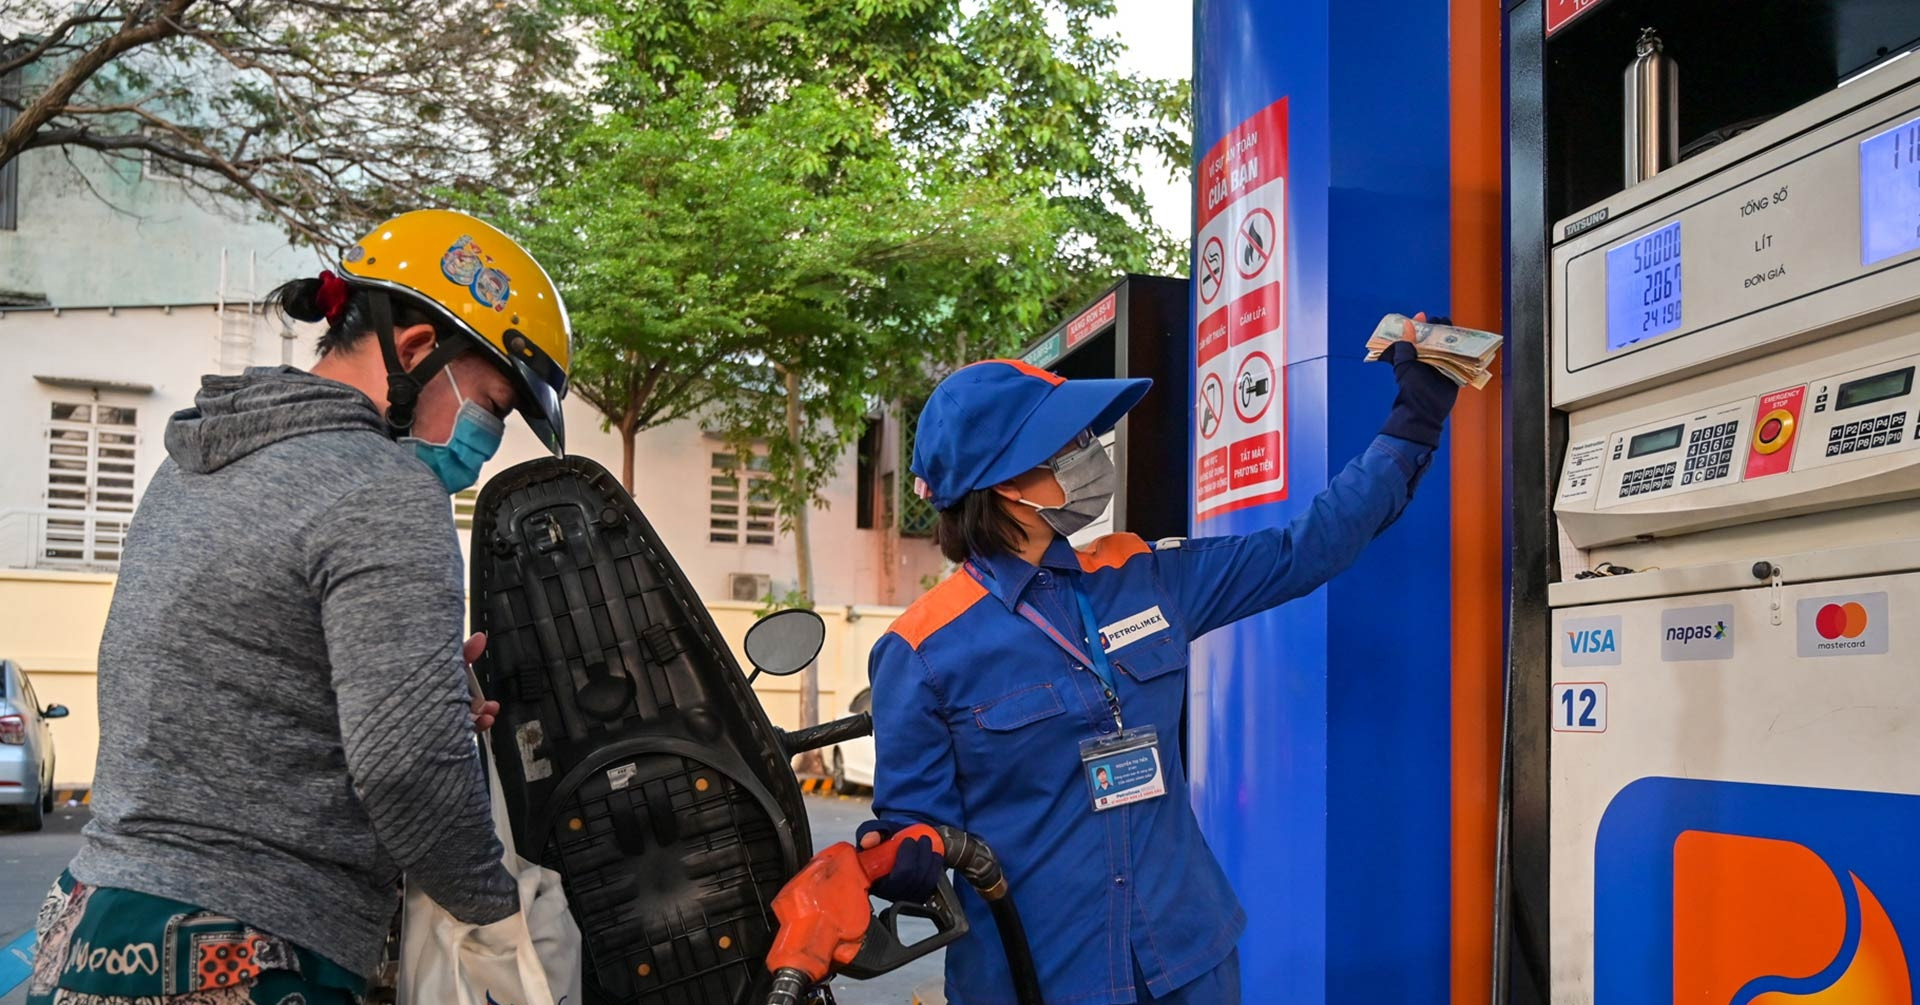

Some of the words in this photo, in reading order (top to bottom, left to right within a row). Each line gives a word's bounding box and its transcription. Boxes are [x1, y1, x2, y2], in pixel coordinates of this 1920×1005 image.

[1236, 131, 1258, 153] TOÀN
[1208, 176, 1228, 210] CỦA
[1231, 156, 1258, 192] BẠN
[1773, 185, 1788, 204] SỐ
[1566, 210, 1607, 236] TATSUNO
[1634, 225, 1681, 274] 50000
[1755, 234, 1773, 252] LÍT
[1767, 263, 1786, 280] GIÁ
[1764, 389, 1801, 403] EMERGENCY
[1772, 399, 1789, 409] STOP
[1692, 431, 1700, 441] 7
[1704, 428, 1711, 438] 8
[1716, 426, 1723, 435] 9
[1830, 428, 1842, 438] P1
[1845, 425, 1858, 435] P2
[1861, 422, 1873, 432] P3
[1876, 418, 1889, 428] P4
[1892, 415, 1905, 425] P5
[1689, 446, 1696, 455] 4
[1701, 443, 1708, 453] 5
[1713, 440, 1720, 450] 6
[1827, 444, 1839, 454] P6
[1842, 441, 1854, 451] P7
[1857, 438, 1870, 448] P8
[1873, 435, 1885, 444] P9
[1888, 432, 1902, 441] P10
[1698, 458, 1705, 467] 2
[1710, 455, 1717, 464] 3
[1684, 474, 1690, 484] 0
[1695, 471, 1703, 481] C
[1108, 614, 1163, 641] PETROLIMEX
[1666, 625, 1713, 645] napas
[1566, 629, 1616, 654] VISA
[1817, 640, 1866, 650] mastercard
[1562, 688, 1597, 727] 12
